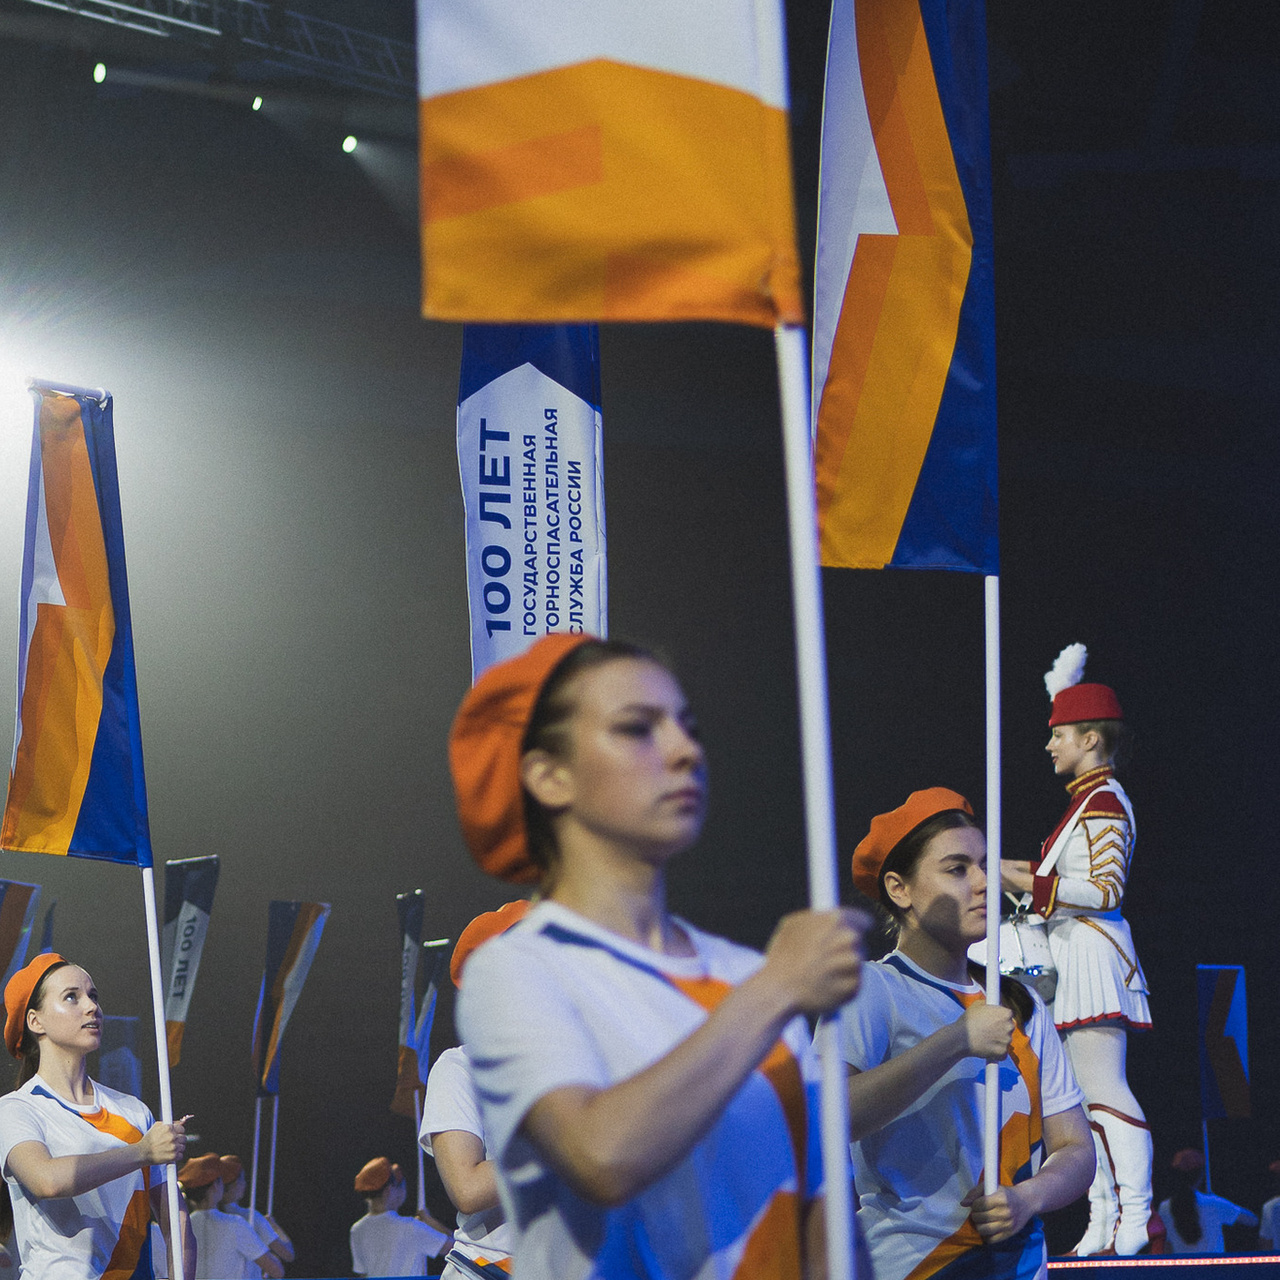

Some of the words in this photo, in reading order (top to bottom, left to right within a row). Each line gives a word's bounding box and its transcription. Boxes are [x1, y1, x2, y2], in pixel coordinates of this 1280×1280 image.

[479, 418, 511, 529] ЛЕТ
[568, 461, 582, 542] РОССИИ
[523, 435, 538, 635] ГОСУДАРСТВЕННАЯ
[545, 409, 560, 635] ГОРНОСПАСАТЕЛЬНАЯ
[482, 545, 511, 638] 100
[570, 549, 583, 634] СЛУЖБА
[181, 914, 197, 952] 100
